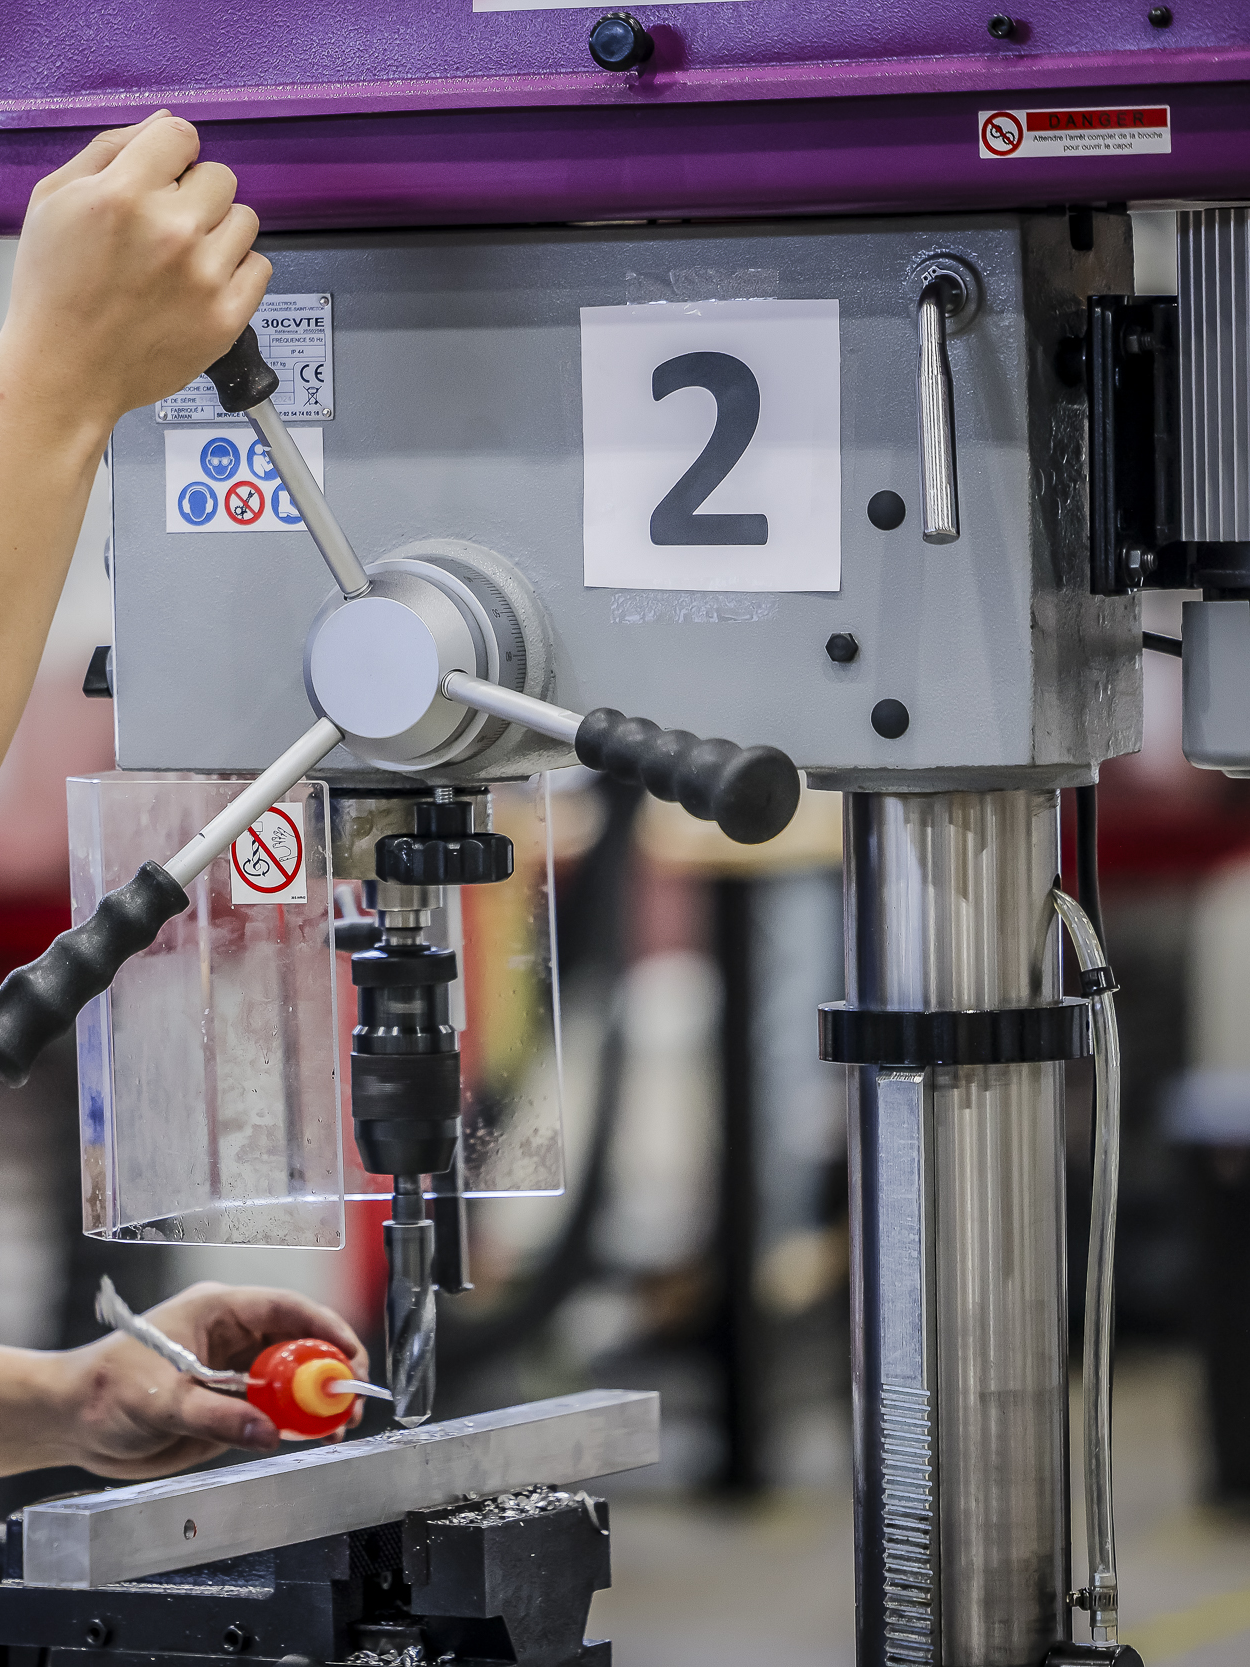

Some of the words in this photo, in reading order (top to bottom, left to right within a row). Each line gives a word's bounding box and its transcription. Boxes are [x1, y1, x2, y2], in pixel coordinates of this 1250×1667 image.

[1048, 111, 1145, 129] DANGER
[1033, 134, 1064, 142] Attendre
[1087, 133, 1117, 142] complet
[1118, 132, 1128, 140] de
[1063, 144, 1080, 152] pour
[1113, 142, 1133, 151] capot
[261, 317, 325, 328] 30CVTE
[180, 396, 197, 404] SÉRIE
[170, 406, 199, 414] FABRIQUÉ
[650, 351, 768, 545] 2
